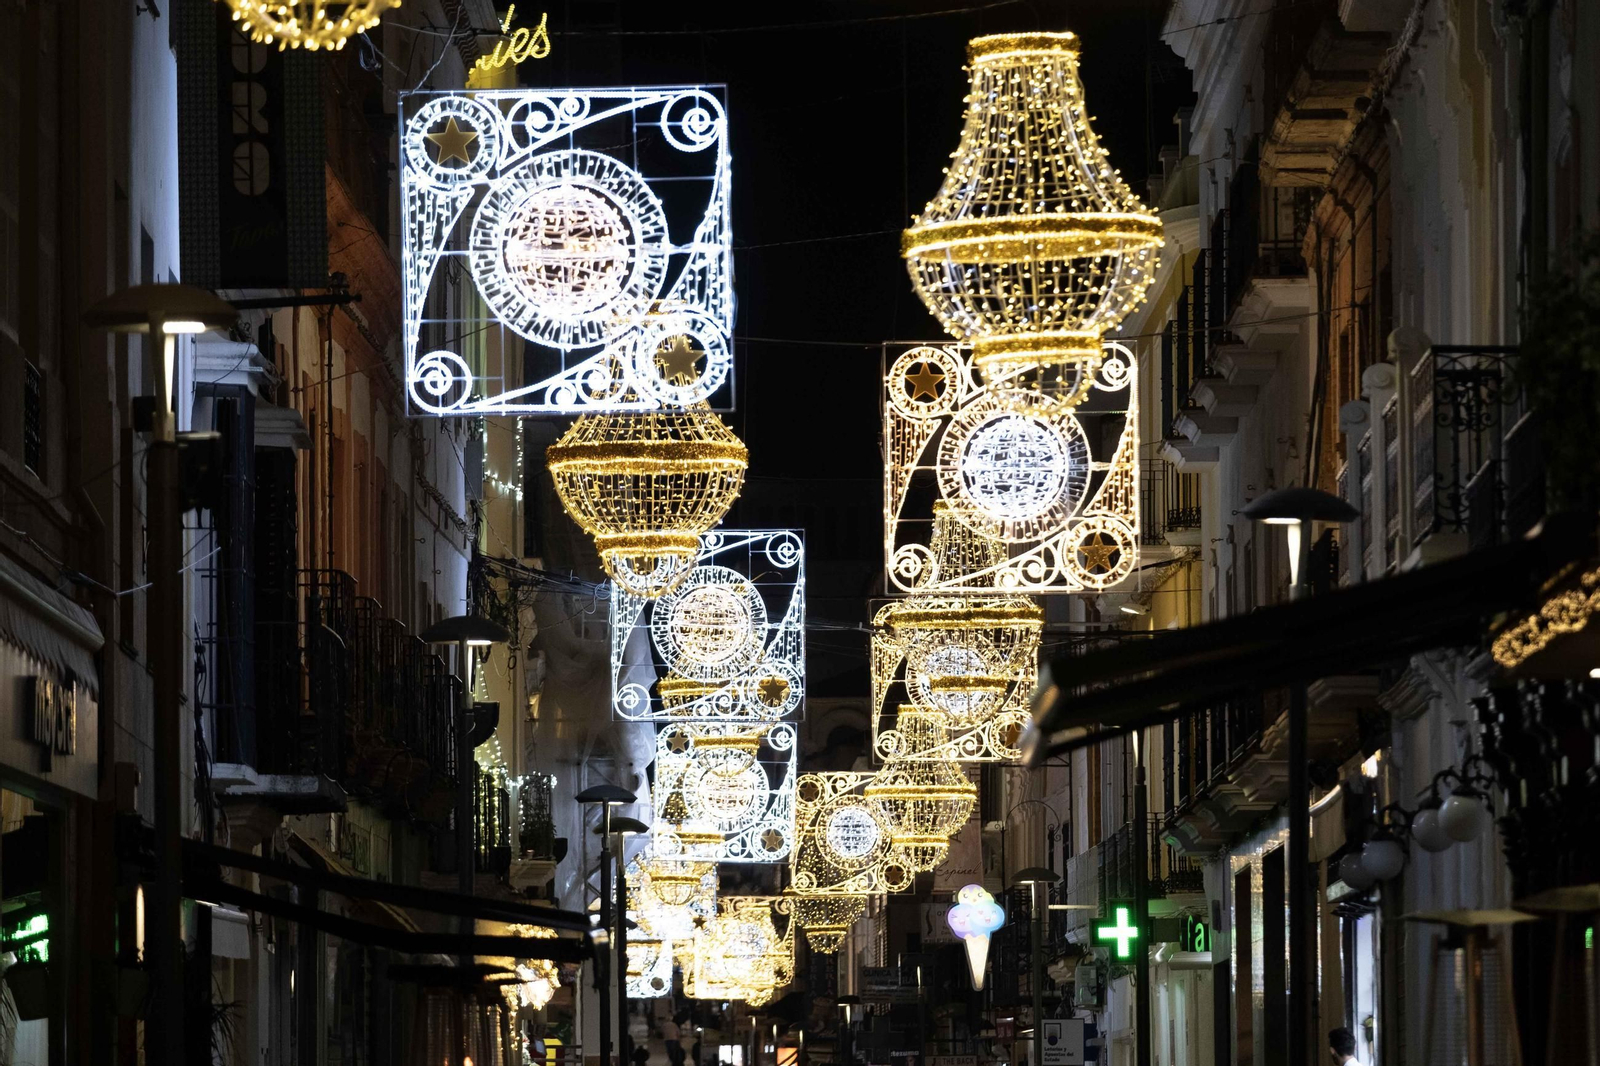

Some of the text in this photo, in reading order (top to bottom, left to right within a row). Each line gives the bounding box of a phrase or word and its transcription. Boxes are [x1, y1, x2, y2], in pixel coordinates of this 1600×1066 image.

[34, 678, 77, 768] mayoral
[935, 860, 982, 882] Espinel
[957, 1057, 975, 1065] BACK
